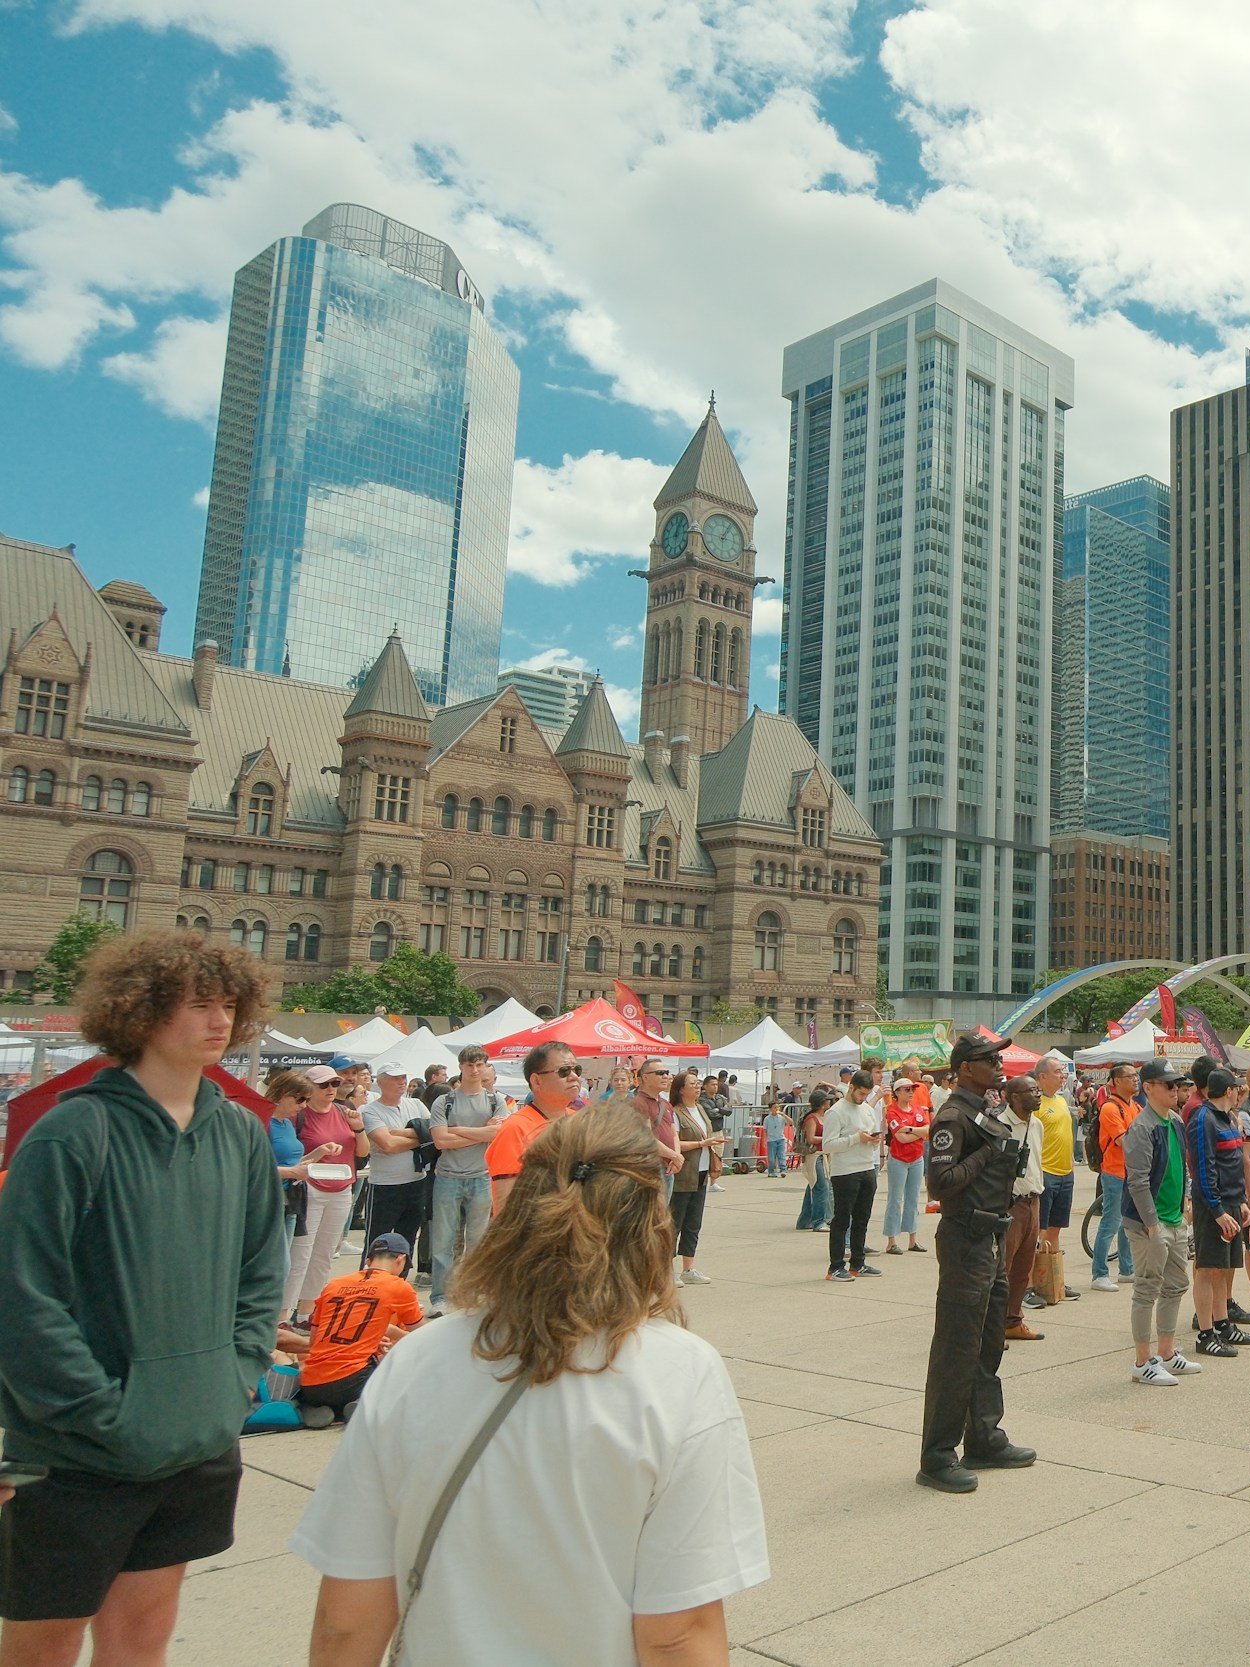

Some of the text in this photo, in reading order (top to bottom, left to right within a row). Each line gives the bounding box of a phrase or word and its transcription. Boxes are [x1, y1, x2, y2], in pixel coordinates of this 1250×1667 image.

[994, 997, 1041, 1036] TORONTO
[600, 1045, 669, 1053] Albaikchicken.ca
[281, 1056, 322, 1065] Colombia
[931, 1155, 953, 1163] SECURITY
[337, 1287, 378, 1296] MEMPHIS
[320, 1296, 380, 1345] 10
